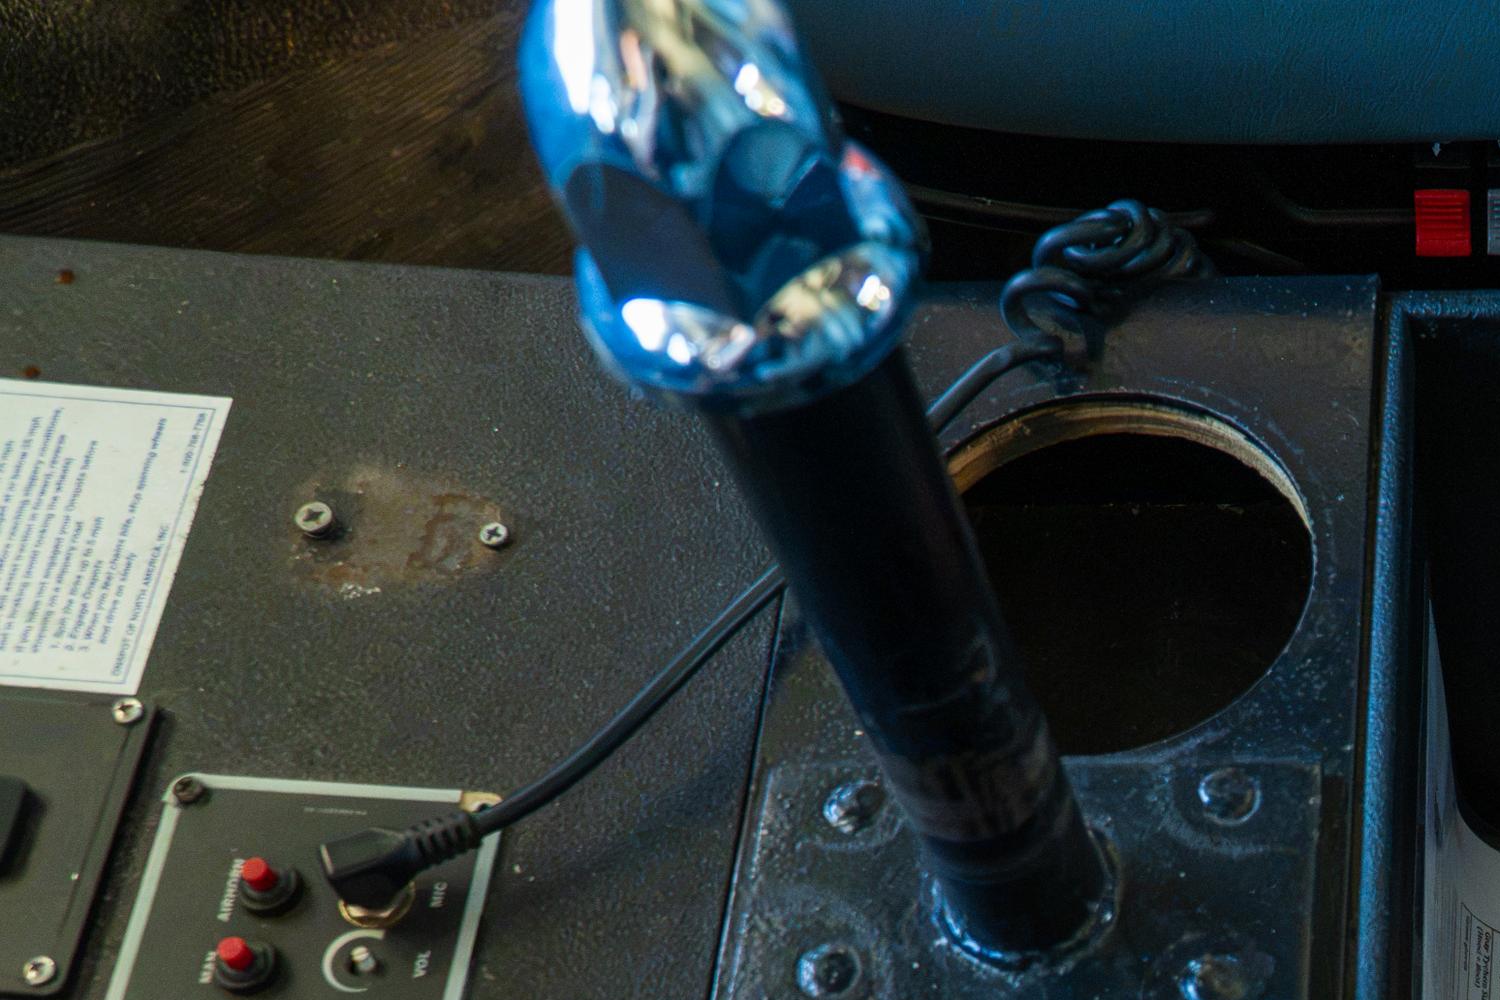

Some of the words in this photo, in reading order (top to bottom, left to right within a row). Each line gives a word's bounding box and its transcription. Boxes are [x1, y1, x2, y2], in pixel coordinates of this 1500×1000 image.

[217, 858, 246, 922] AIRHORN
[429, 881, 448, 908] MIC
[198, 951, 216, 984] MAN
[412, 950, 432, 979] VOL
